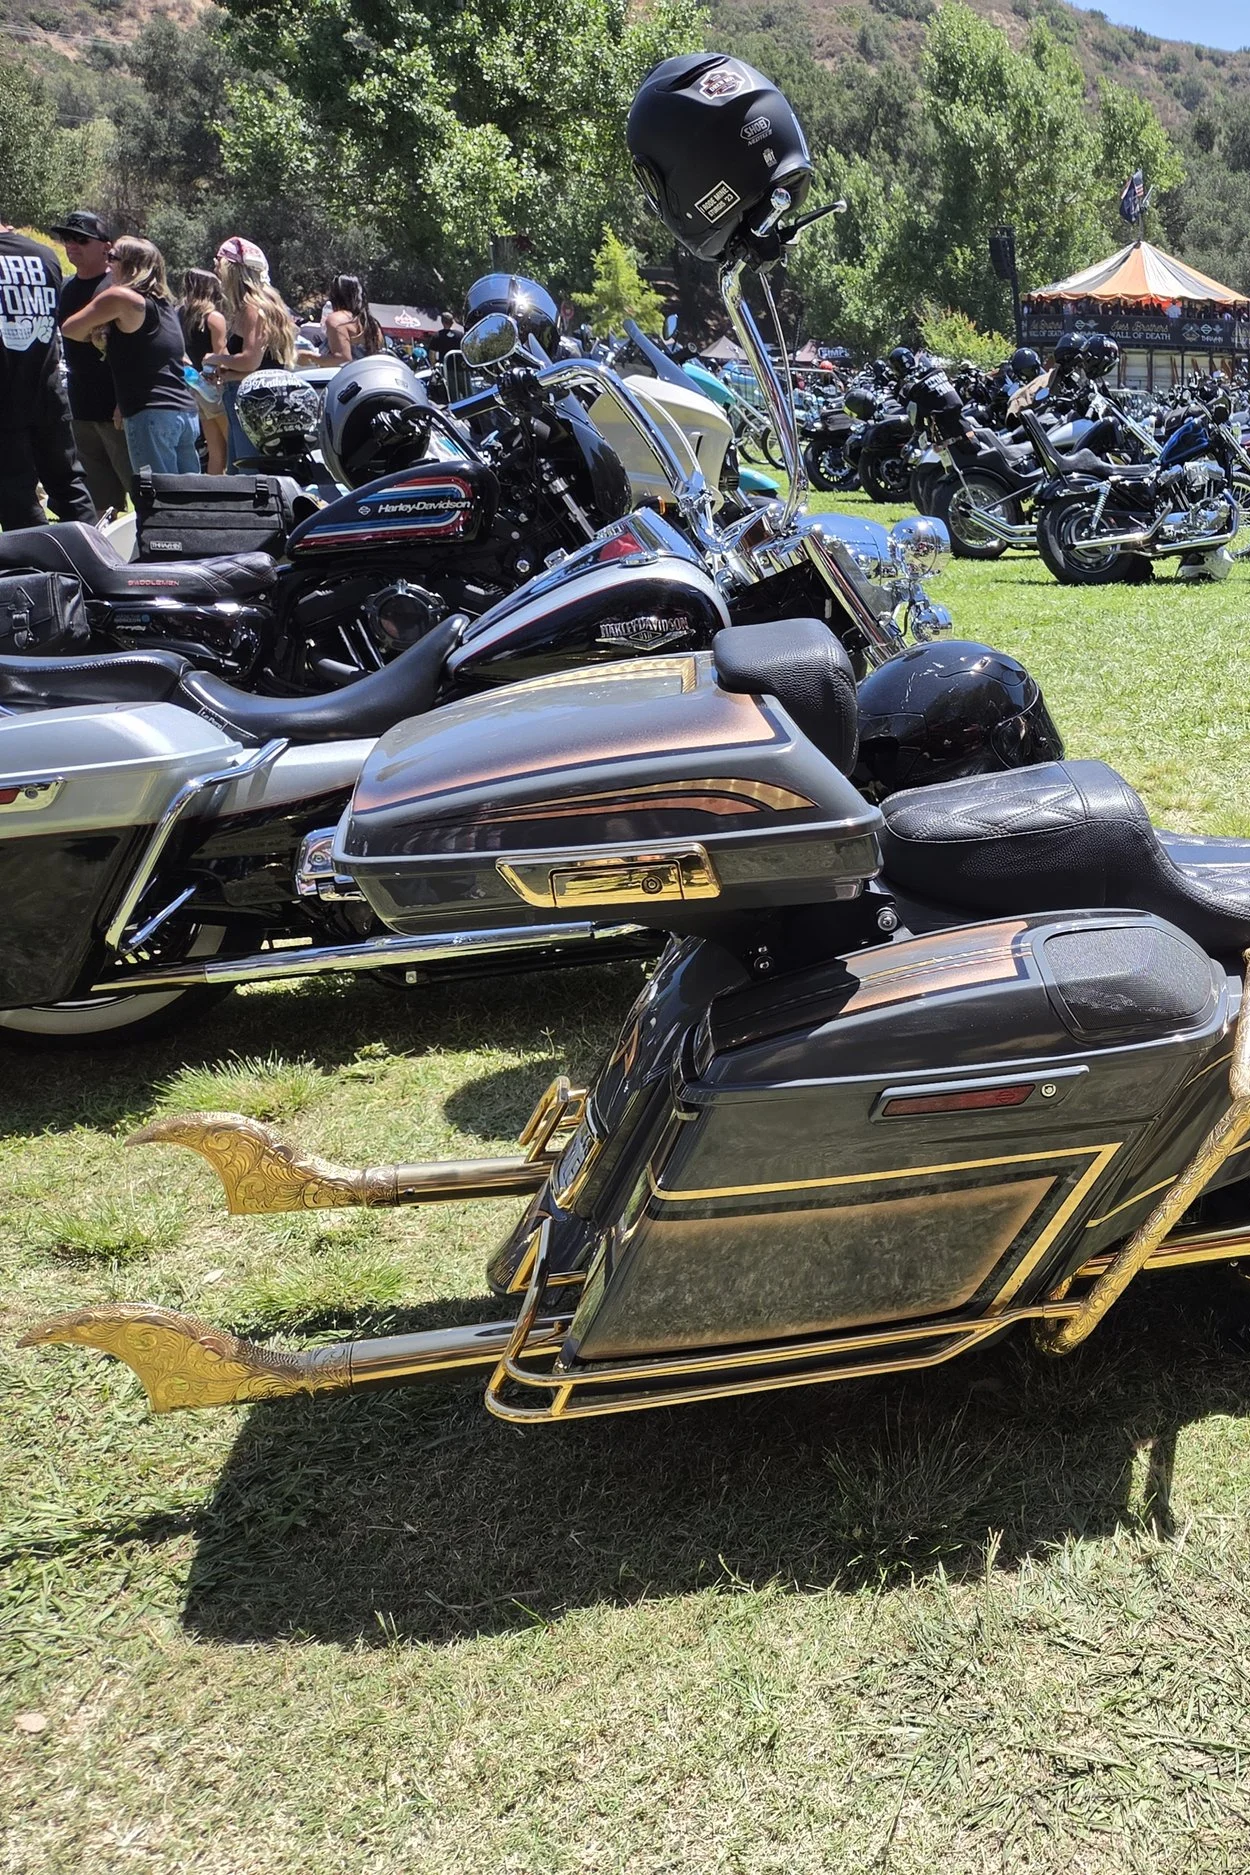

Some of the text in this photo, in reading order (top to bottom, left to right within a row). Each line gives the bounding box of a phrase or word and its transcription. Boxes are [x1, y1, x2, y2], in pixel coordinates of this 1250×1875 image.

[1132, 332, 1143, 340] OF
[1145, 332, 1171, 341] DEATH
[378, 499, 471, 514] Harley-Davidson
